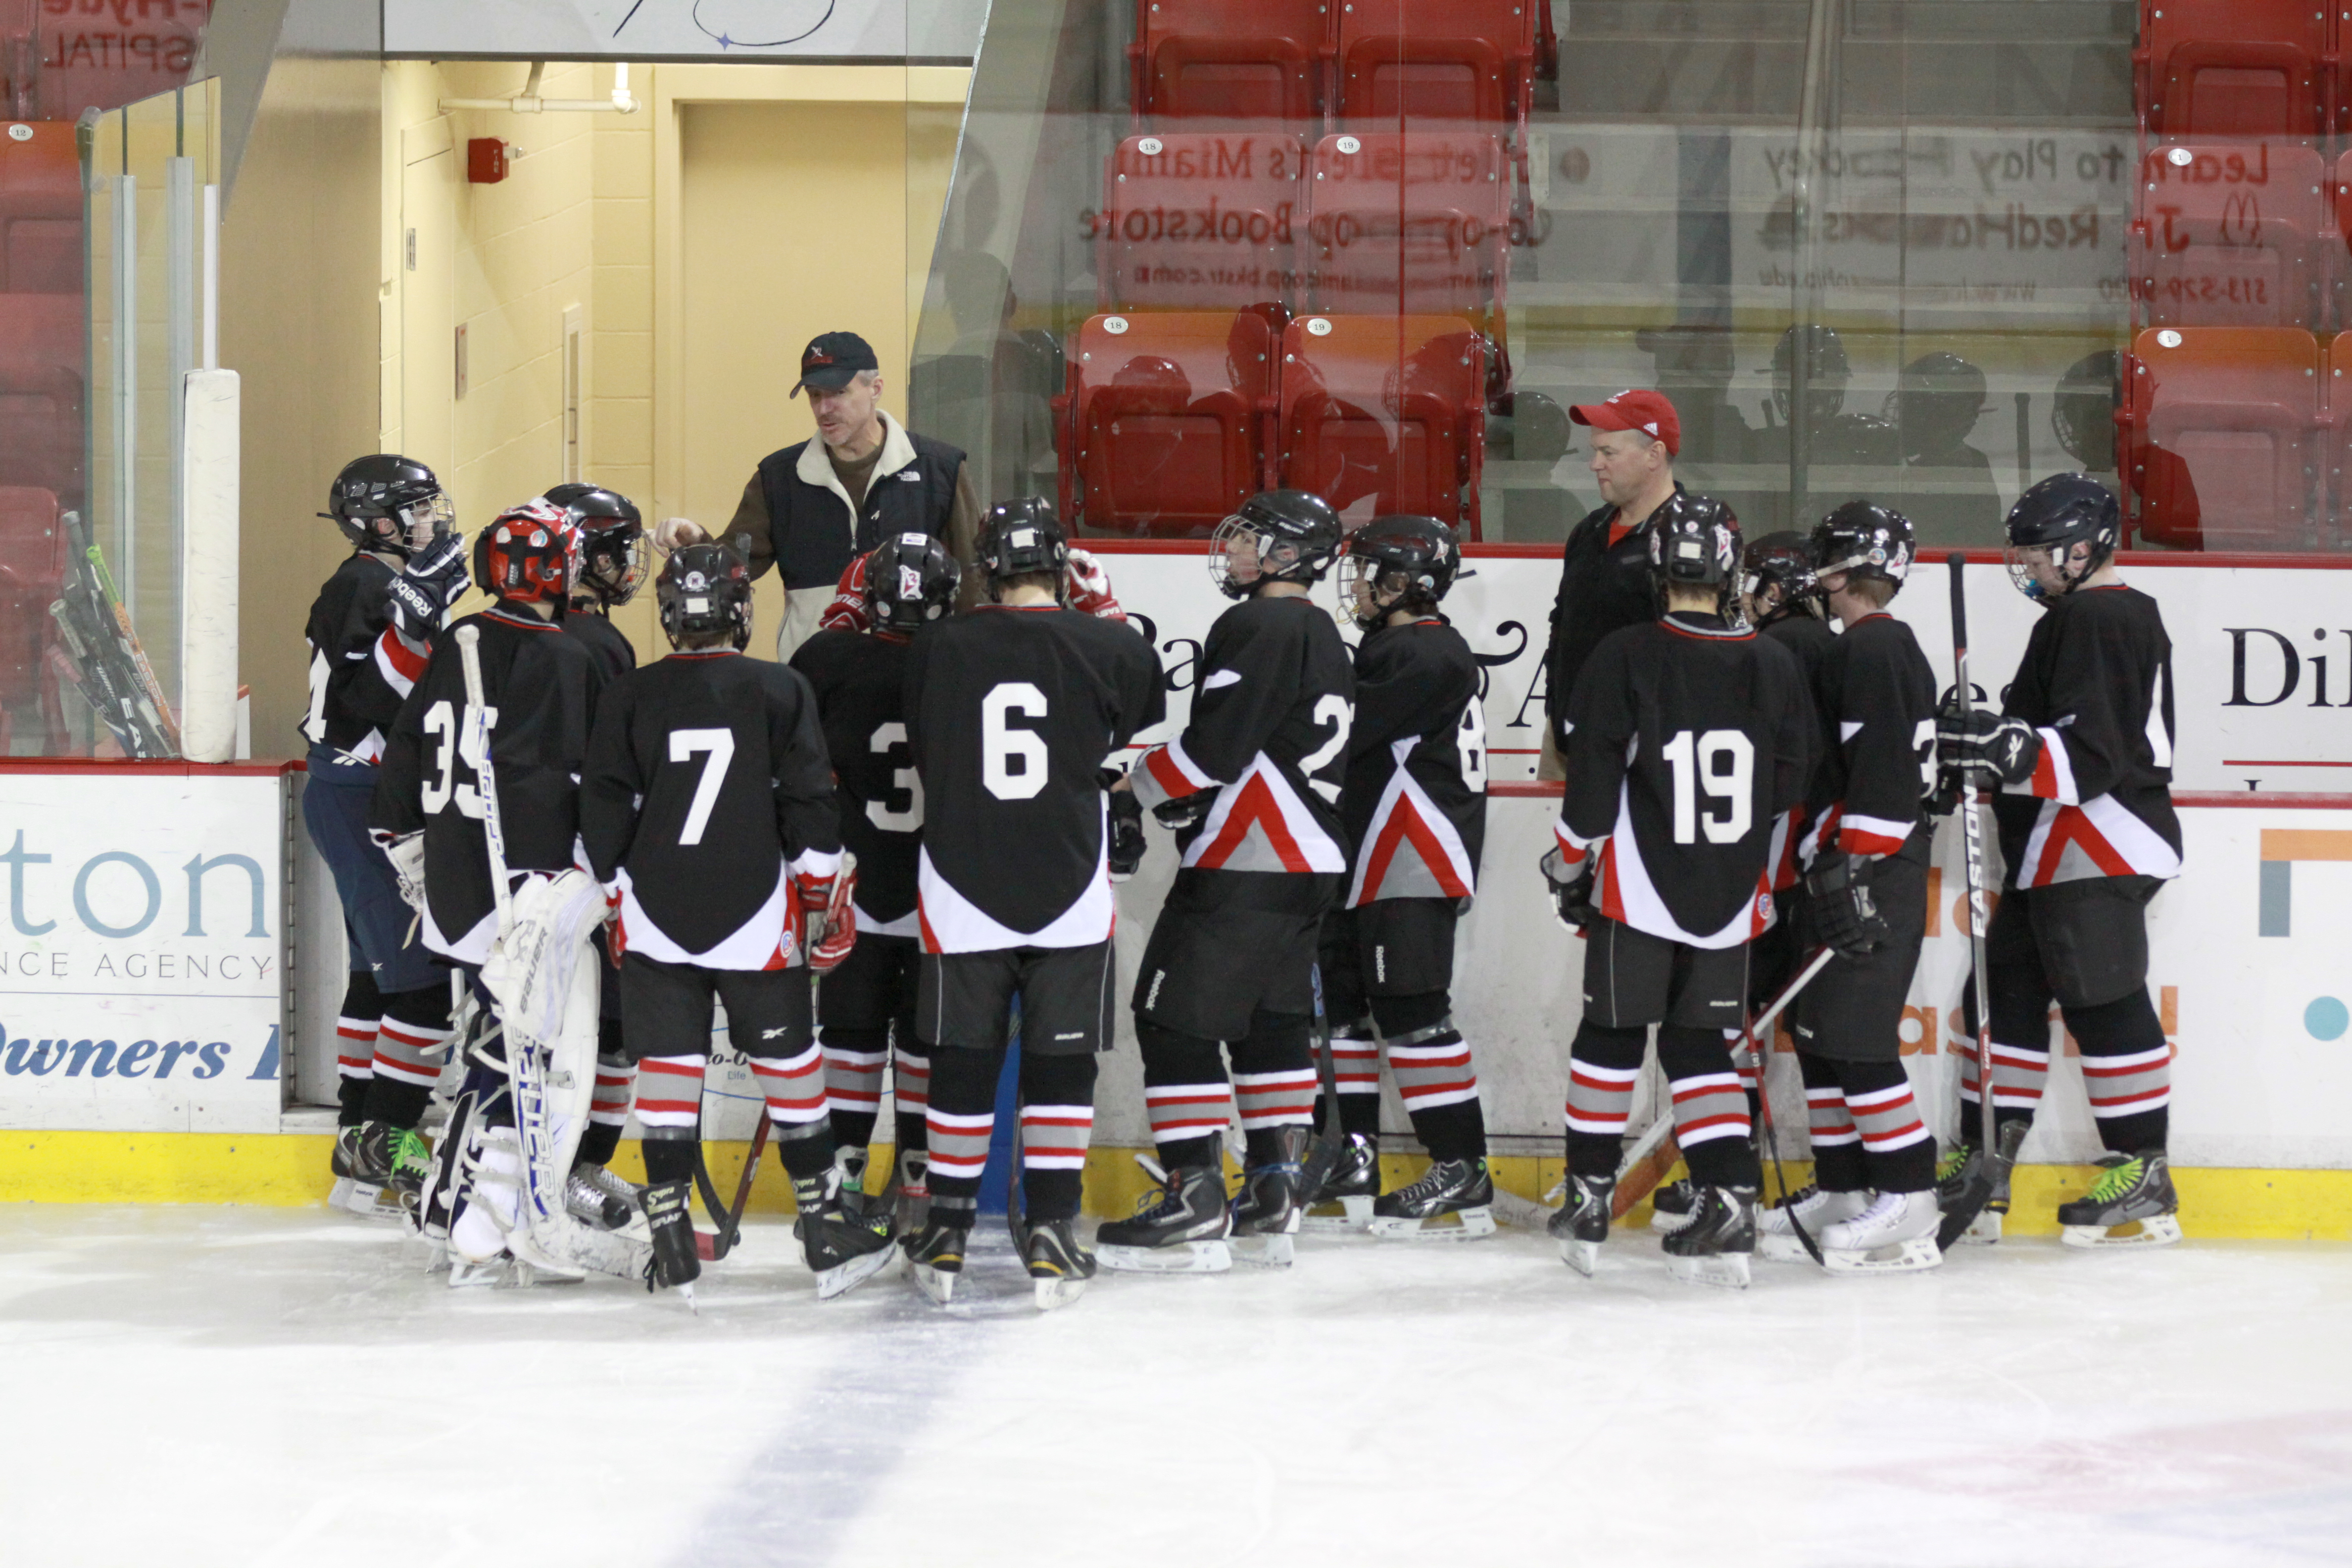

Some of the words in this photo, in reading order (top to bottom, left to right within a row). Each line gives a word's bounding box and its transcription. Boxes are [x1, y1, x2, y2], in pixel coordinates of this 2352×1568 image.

[669, 728, 735, 845] 7
[982, 683, 1048, 800] 6
[1297, 693, 1354, 804] 2
[1662, 729, 1755, 844] 19
[0, 829, 271, 939] ton
[1962, 784, 1986, 938] EASTON
[95, 952, 272, 981] AGENCY
[1144, 969, 1166, 1011] Reebok
[1375, 945, 1386, 983] Reebok
[0, 1023, 231, 1080] wners
[728, 1071, 746, 1080] Life
